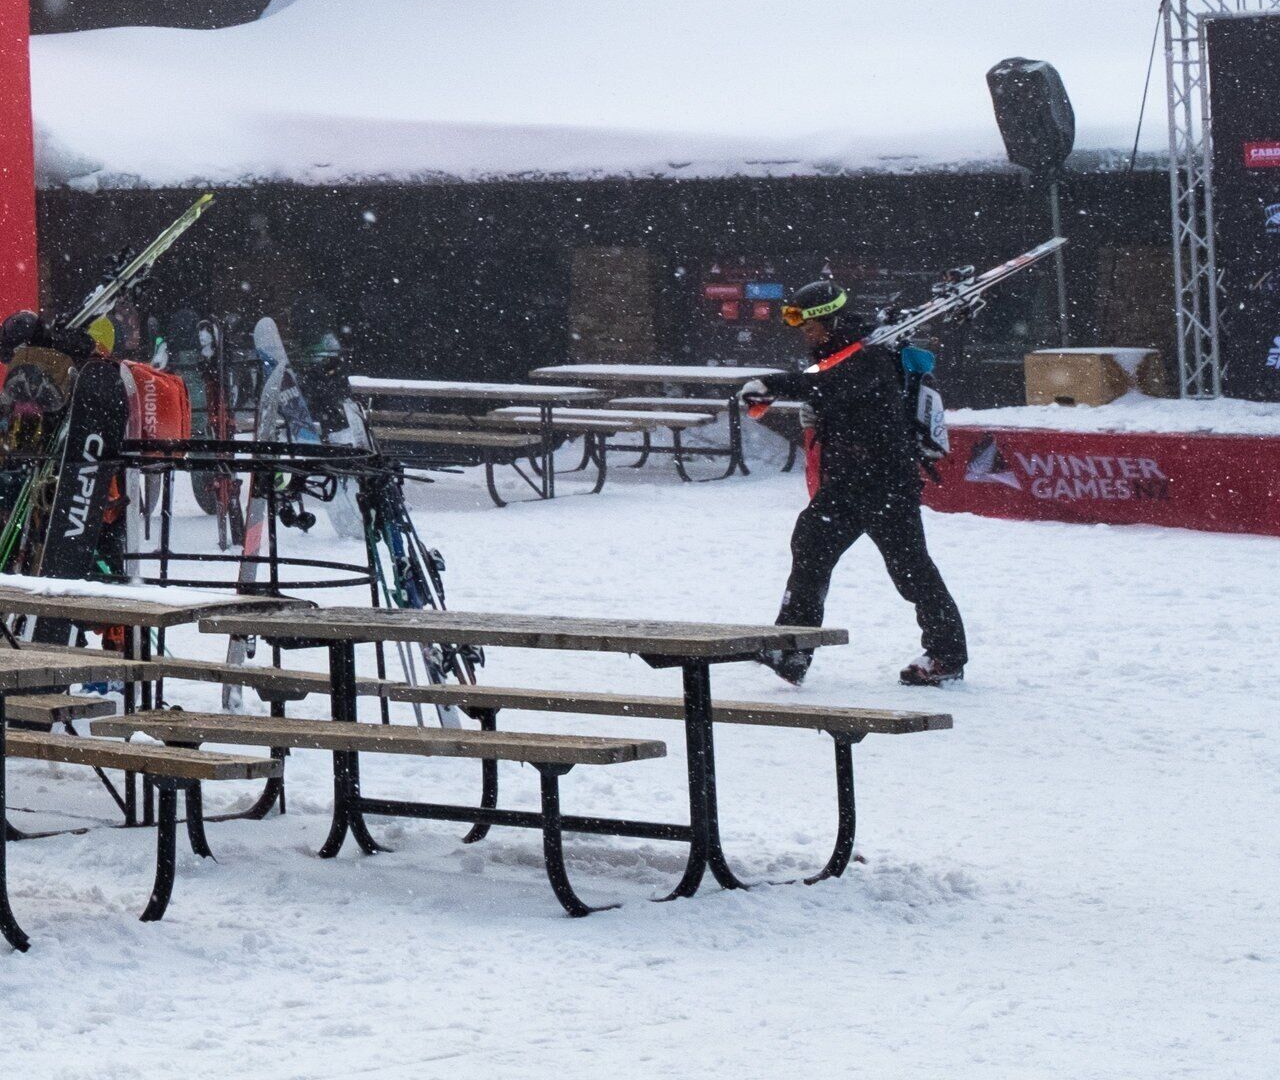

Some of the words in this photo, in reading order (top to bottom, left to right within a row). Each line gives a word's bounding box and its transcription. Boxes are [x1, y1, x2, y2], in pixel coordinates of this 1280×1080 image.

[144, 376, 157, 440] SSIGNOL
[64, 434, 103, 537] CAPITA
[1016, 453, 1166, 479] WINTER
[1031, 479, 1131, 499] GAMES
